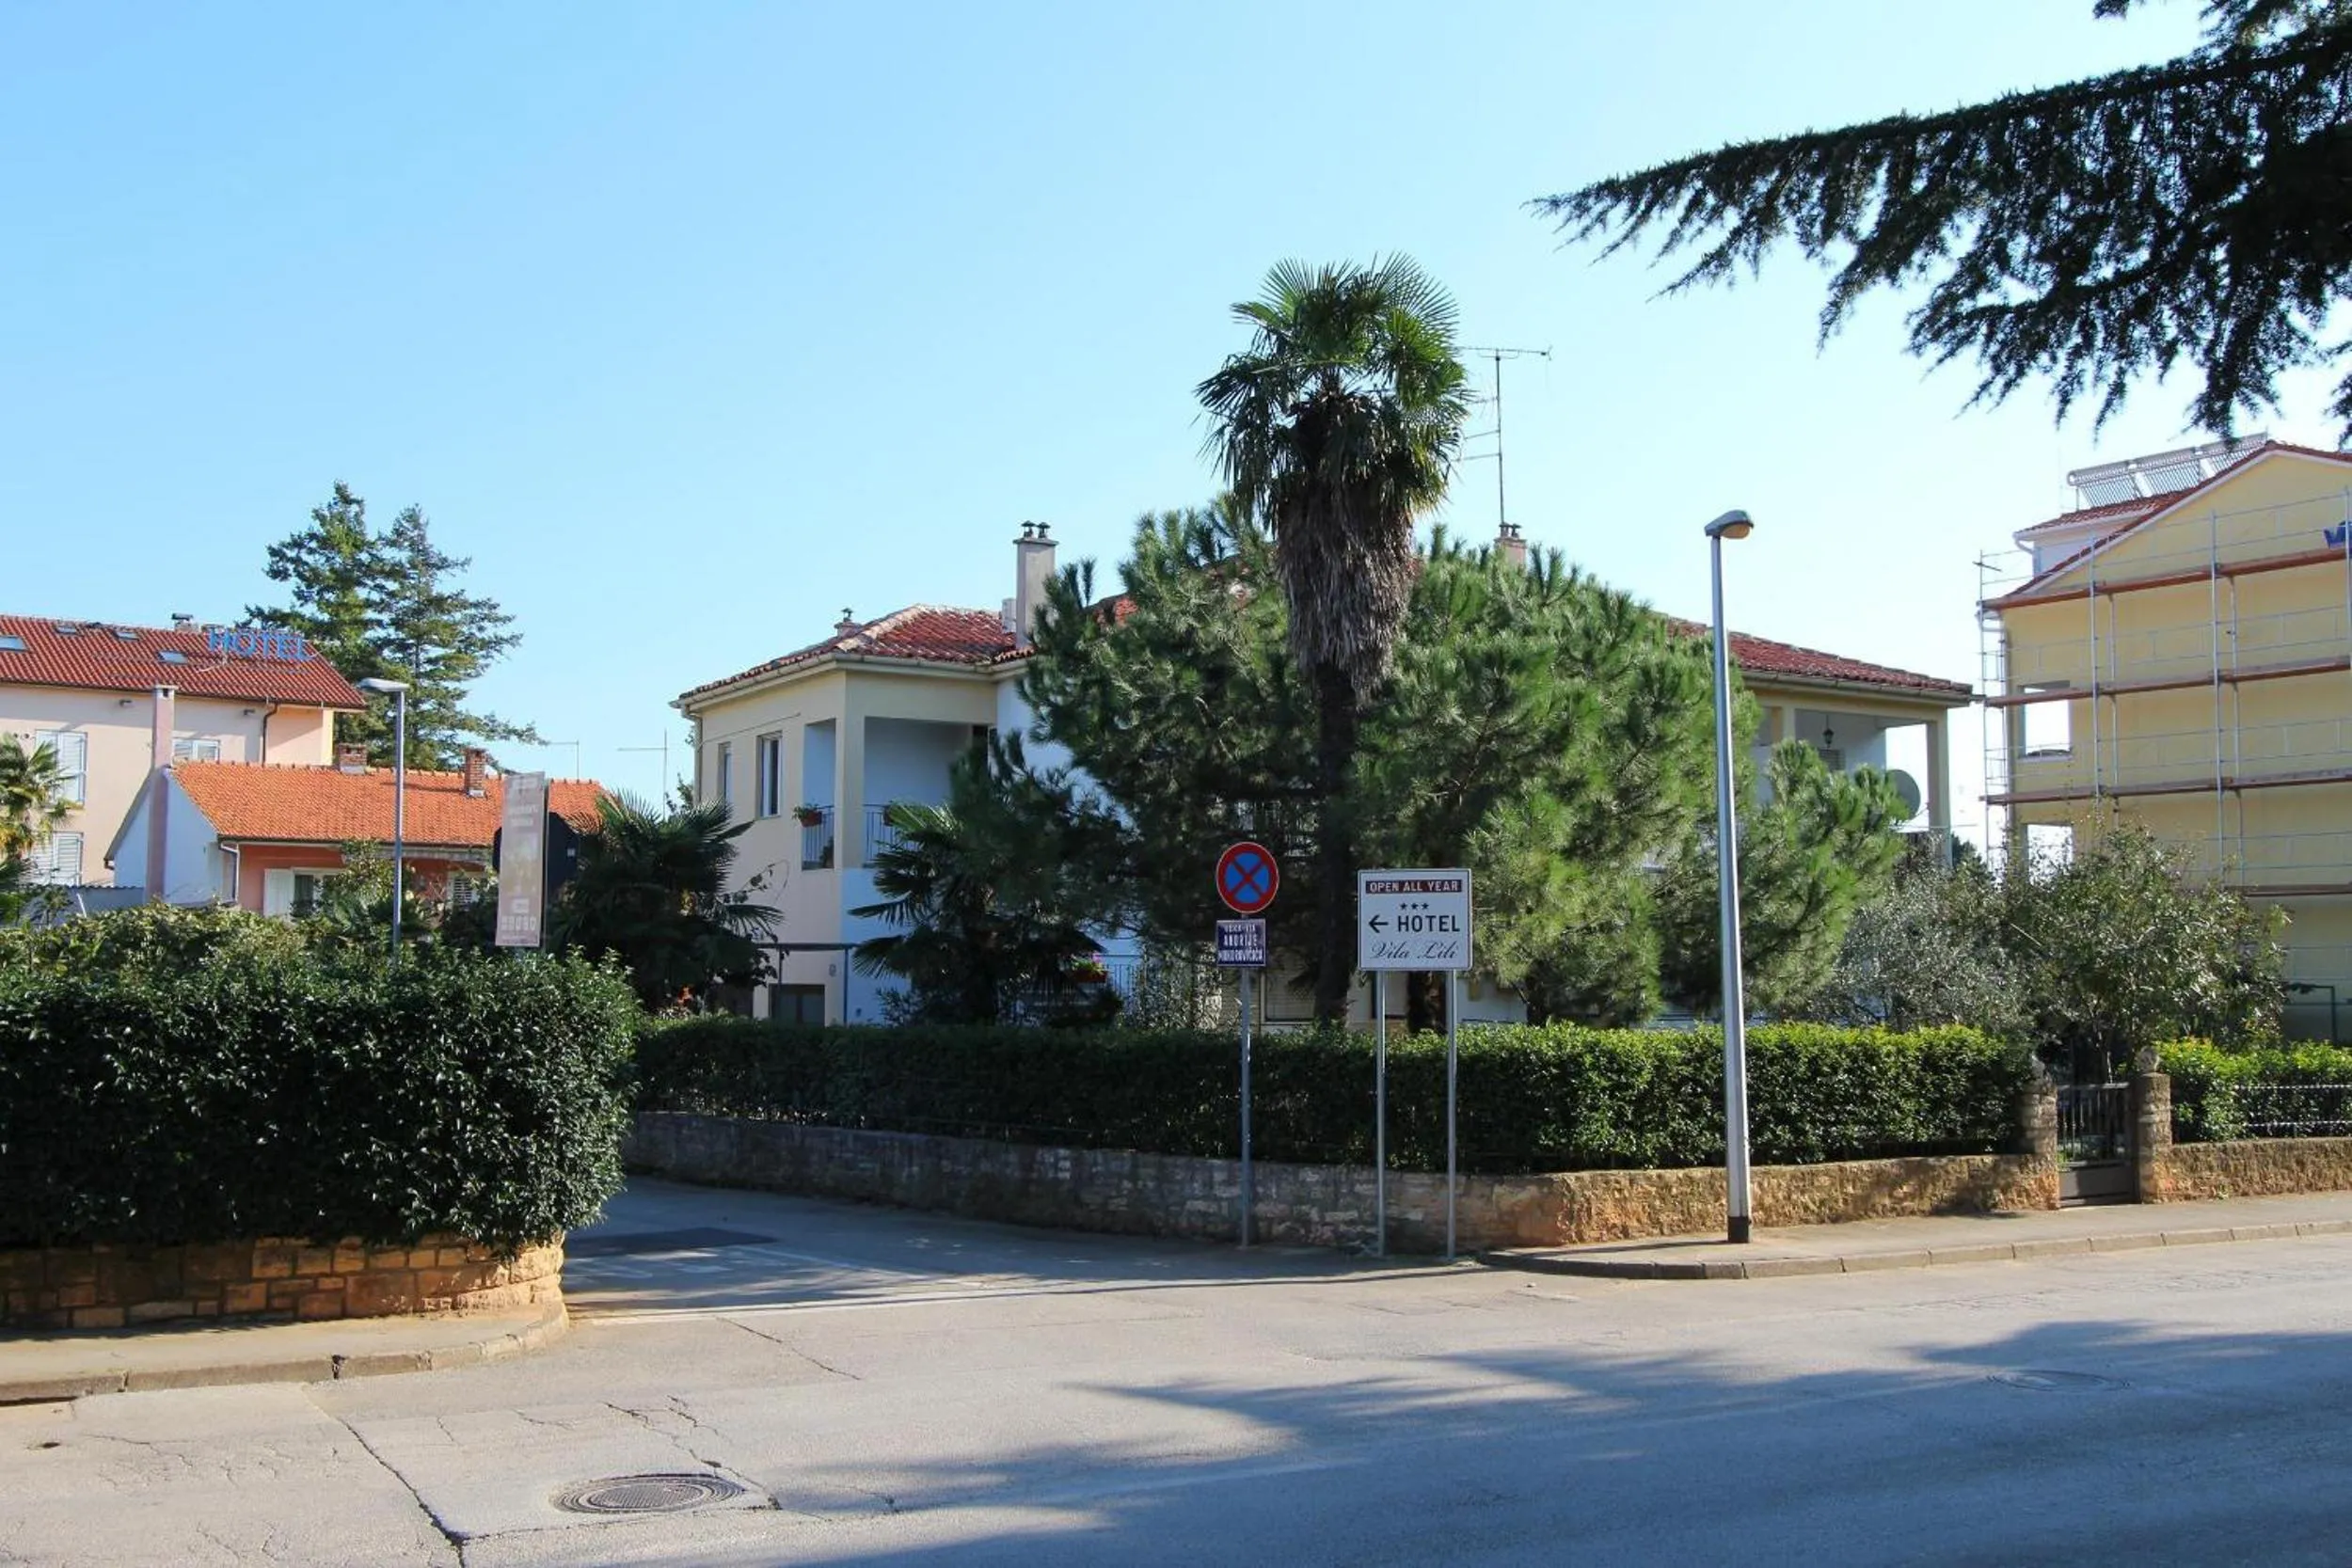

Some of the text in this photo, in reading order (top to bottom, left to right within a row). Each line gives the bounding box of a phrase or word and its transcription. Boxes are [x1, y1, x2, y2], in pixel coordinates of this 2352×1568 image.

[209, 626, 313, 661] HOTEL
[1370, 880, 1458, 893] OPEN ALL YEAR
[1397, 914, 1460, 932] HOTEL
[1370, 940, 1409, 959] Vila
